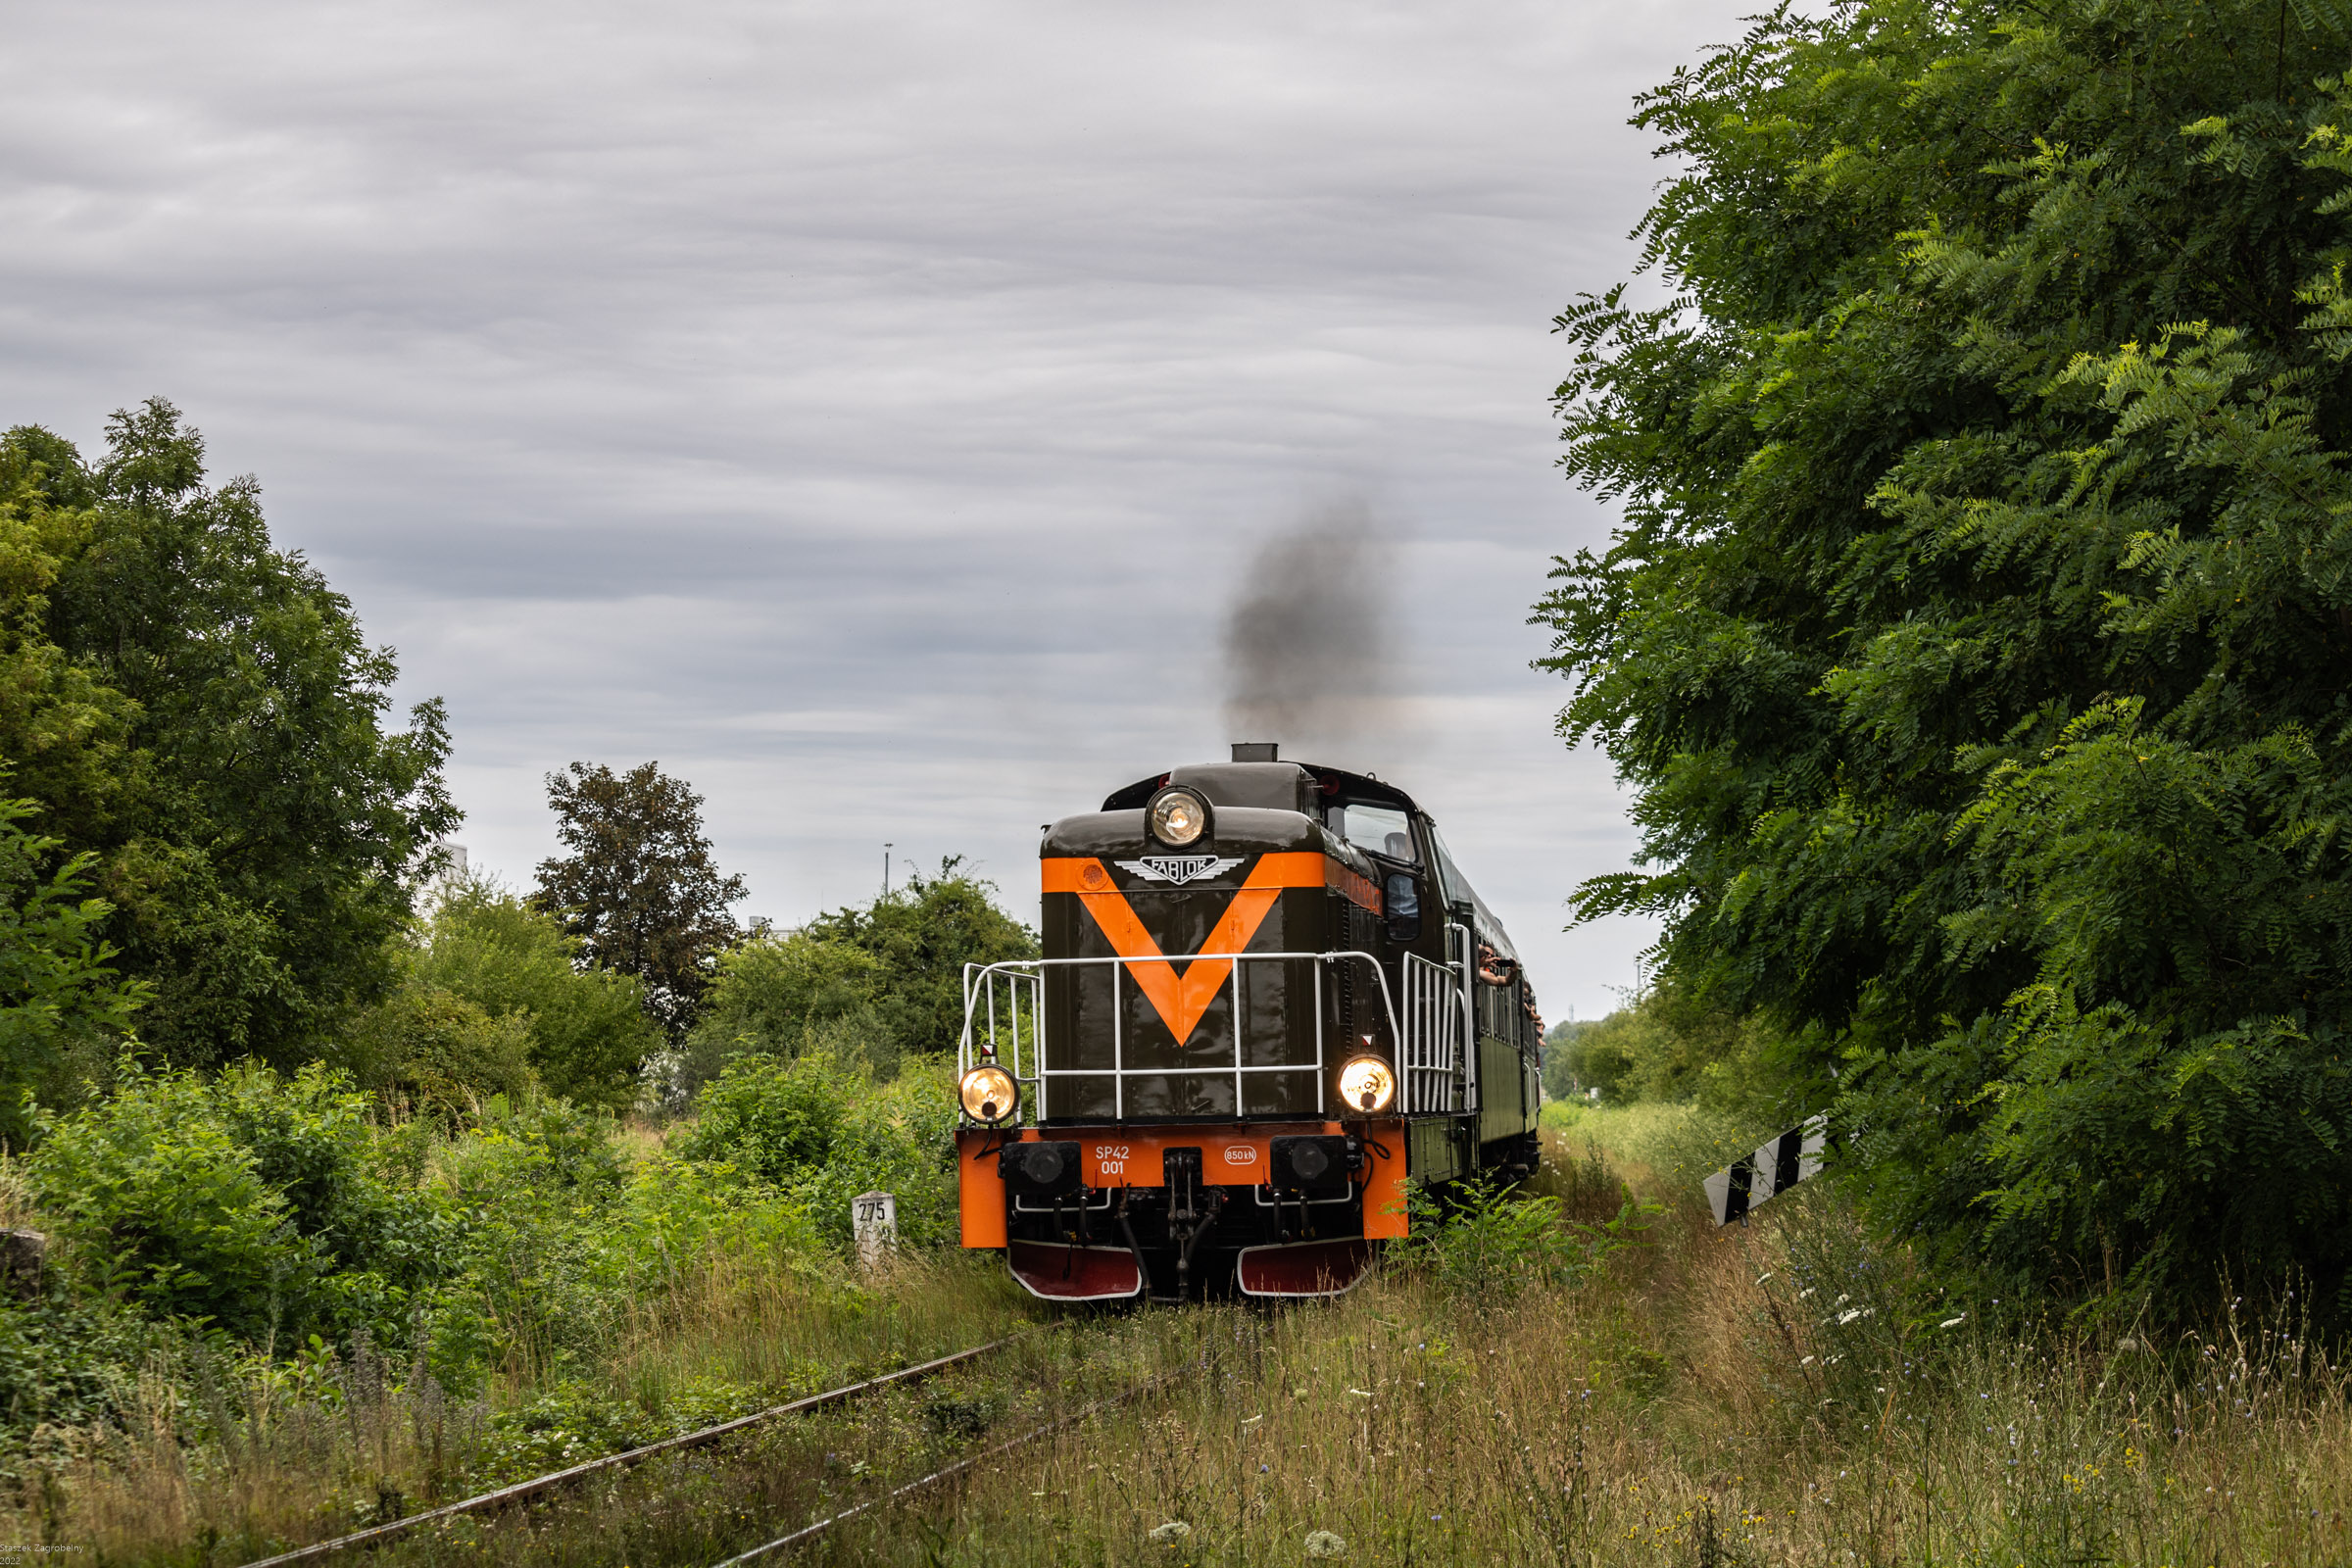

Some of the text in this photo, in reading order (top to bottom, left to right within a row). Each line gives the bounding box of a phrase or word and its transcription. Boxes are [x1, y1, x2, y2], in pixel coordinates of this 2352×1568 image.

[1152, 860, 1206, 881] FABLOK
[1096, 1146, 1129, 1159] SP42
[1226, 1151, 1254, 1160] 850 kN
[1101, 1161, 1123, 1174] 001
[858, 1201, 885, 1221] 275
